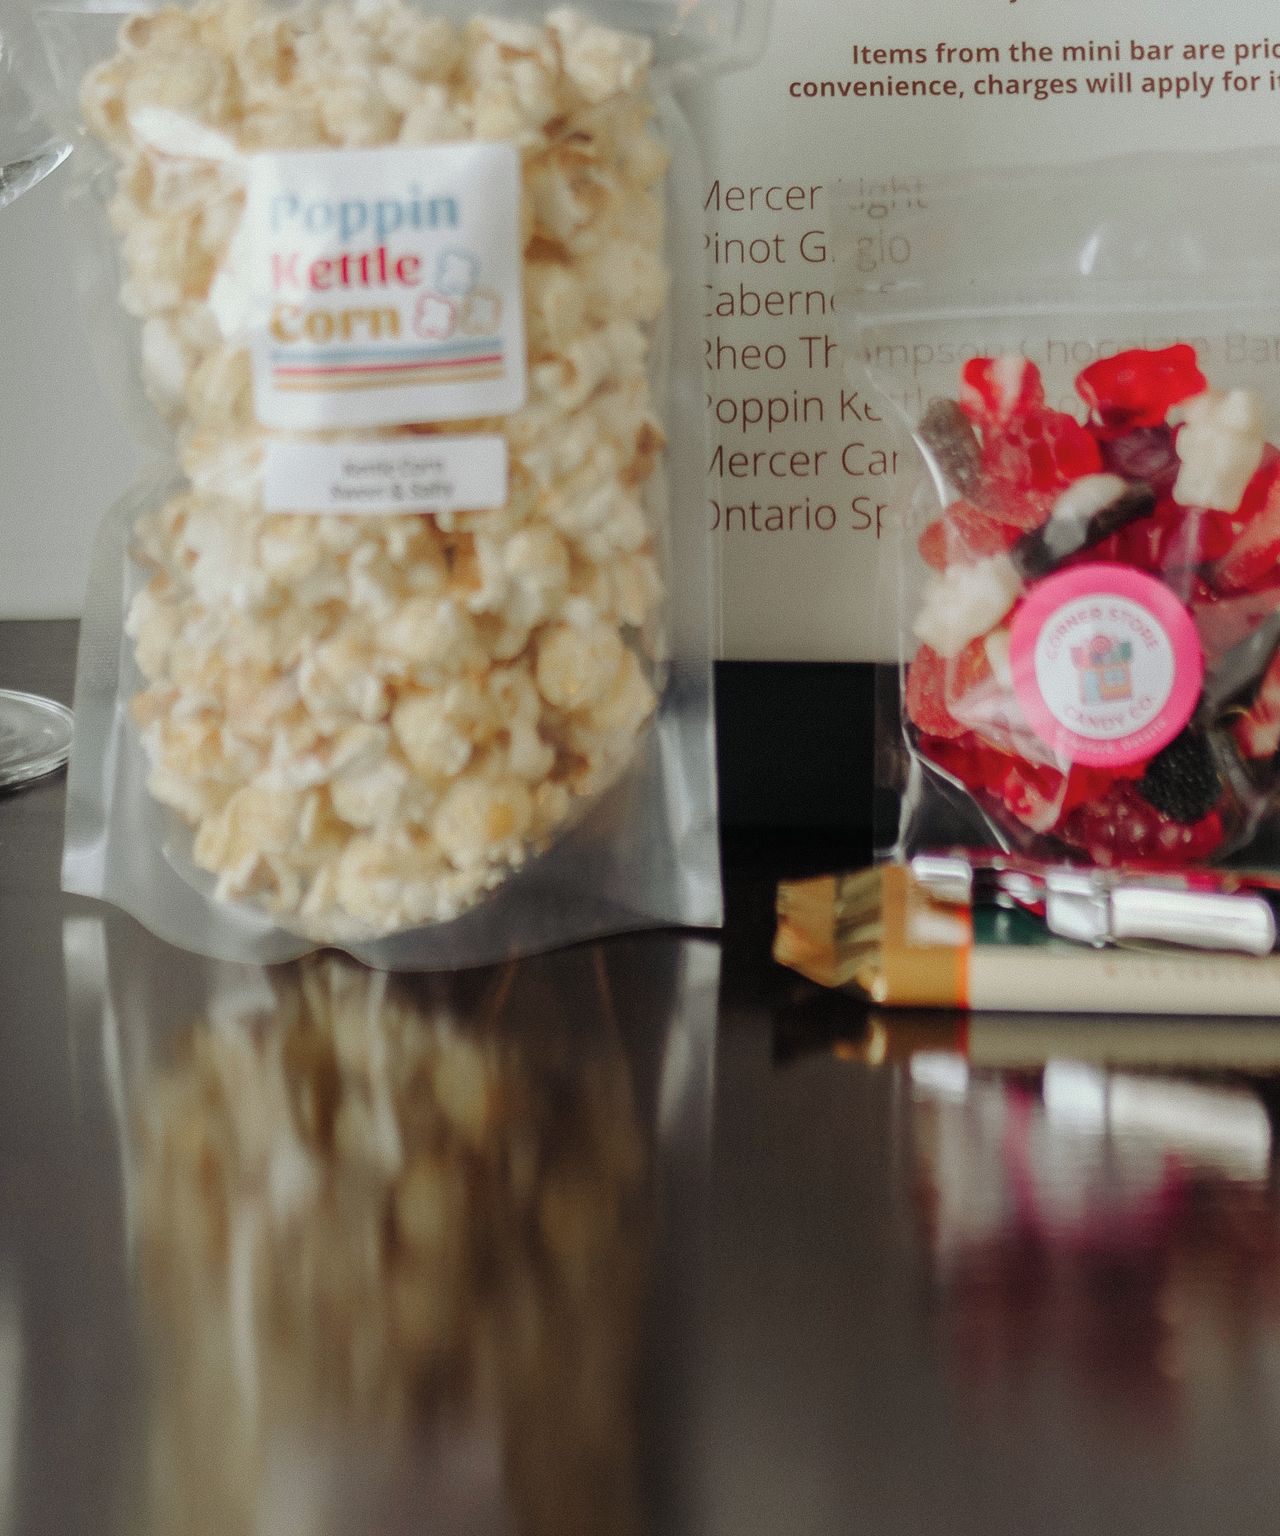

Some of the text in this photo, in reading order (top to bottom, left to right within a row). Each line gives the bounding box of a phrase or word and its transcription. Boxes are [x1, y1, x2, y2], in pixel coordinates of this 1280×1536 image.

[852, 44, 928, 65] Items
[934, 41, 1000, 64] from
[1008, 40, 1054, 63] the
[1061, 39, 1121, 62] mini
[1129, 39, 1175, 61] bar
[1182, 43, 1226, 61] are
[788, 75, 965, 101] convenience,
[973, 73, 1078, 102] charges
[1085, 71, 1133, 94] will
[1140, 70, 1215, 100] apply
[1221, 70, 1262, 93] for
[271, 185, 459, 243] Poppin
[271, 244, 421, 293] Kettle
[800, 230, 911, 272] Ggio
[705, 282, 838, 317] abern
[269, 301, 401, 345] Corn
[705, 389, 824, 434] oppin
